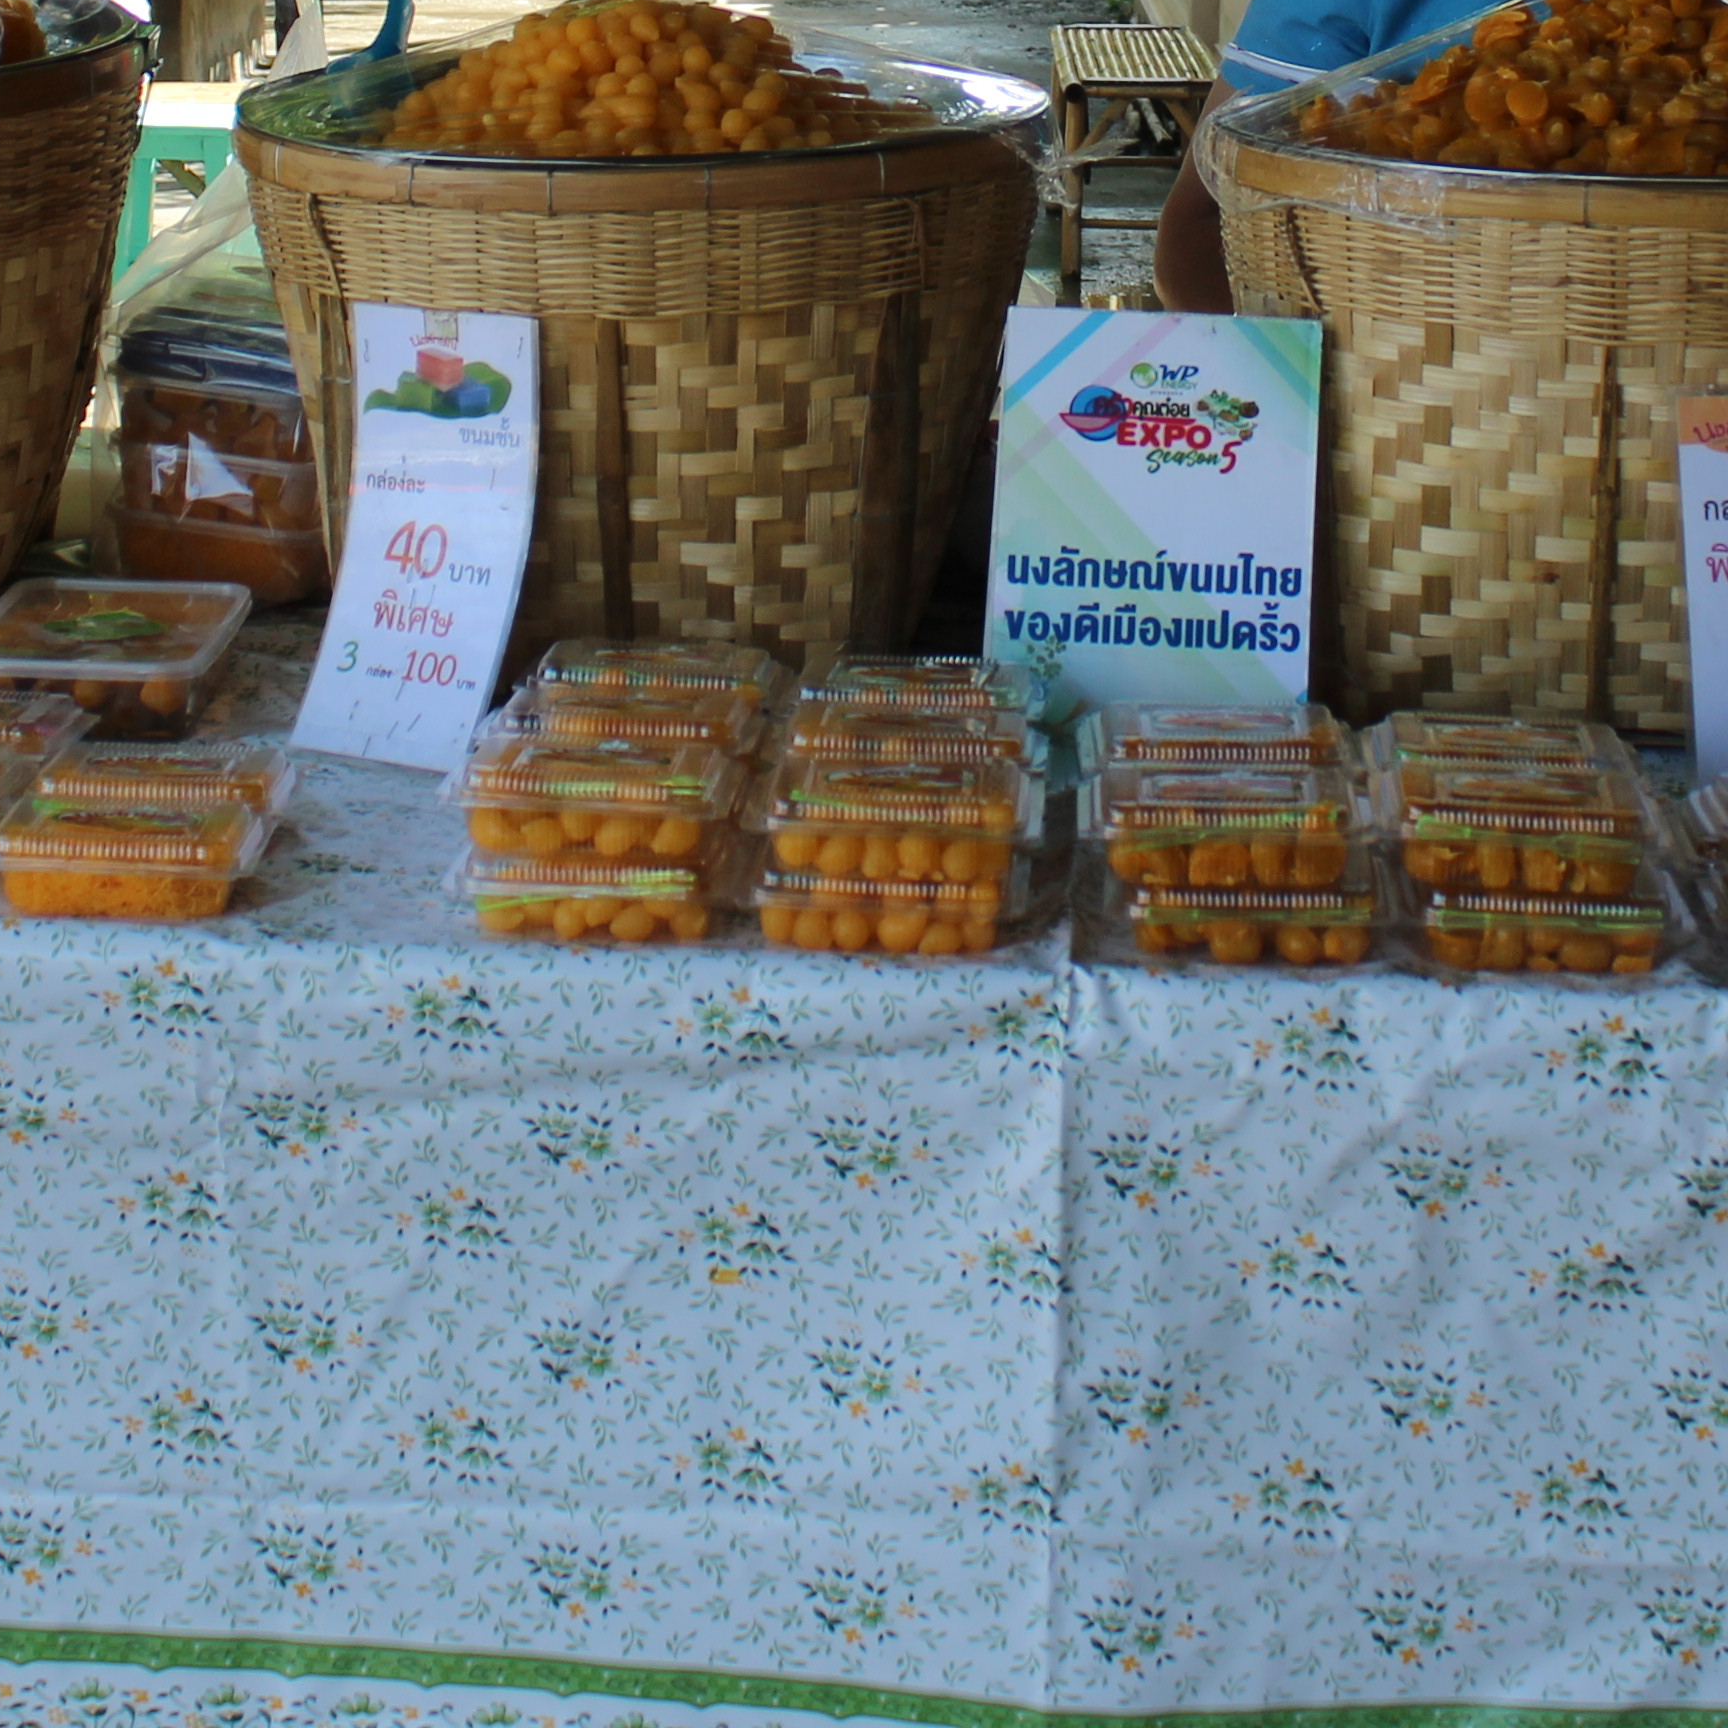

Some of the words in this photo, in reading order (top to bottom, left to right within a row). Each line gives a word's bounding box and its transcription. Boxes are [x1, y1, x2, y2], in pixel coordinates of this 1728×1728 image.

[1159, 364, 1200, 382] WP
[459, 417, 520, 448] ขนมชั้น
[1116, 421, 1213, 450] EXPO
[1146, 448, 1221, 474] Season
[1219, 440, 1243, 474] 5
[366, 469, 426, 494] กล่องละ
[383, 520, 449, 580] 40
[448, 562, 492, 587] บาท
[1006, 545, 1303, 598] นงลักษณ์ขนมไทย
[373, 588, 454, 638] พิเศษ
[1003, 601, 1302, 653] ของดีเมืองแปดริ้ว
[336, 640, 360, 673] 3
[400, 648, 458, 687] 100
